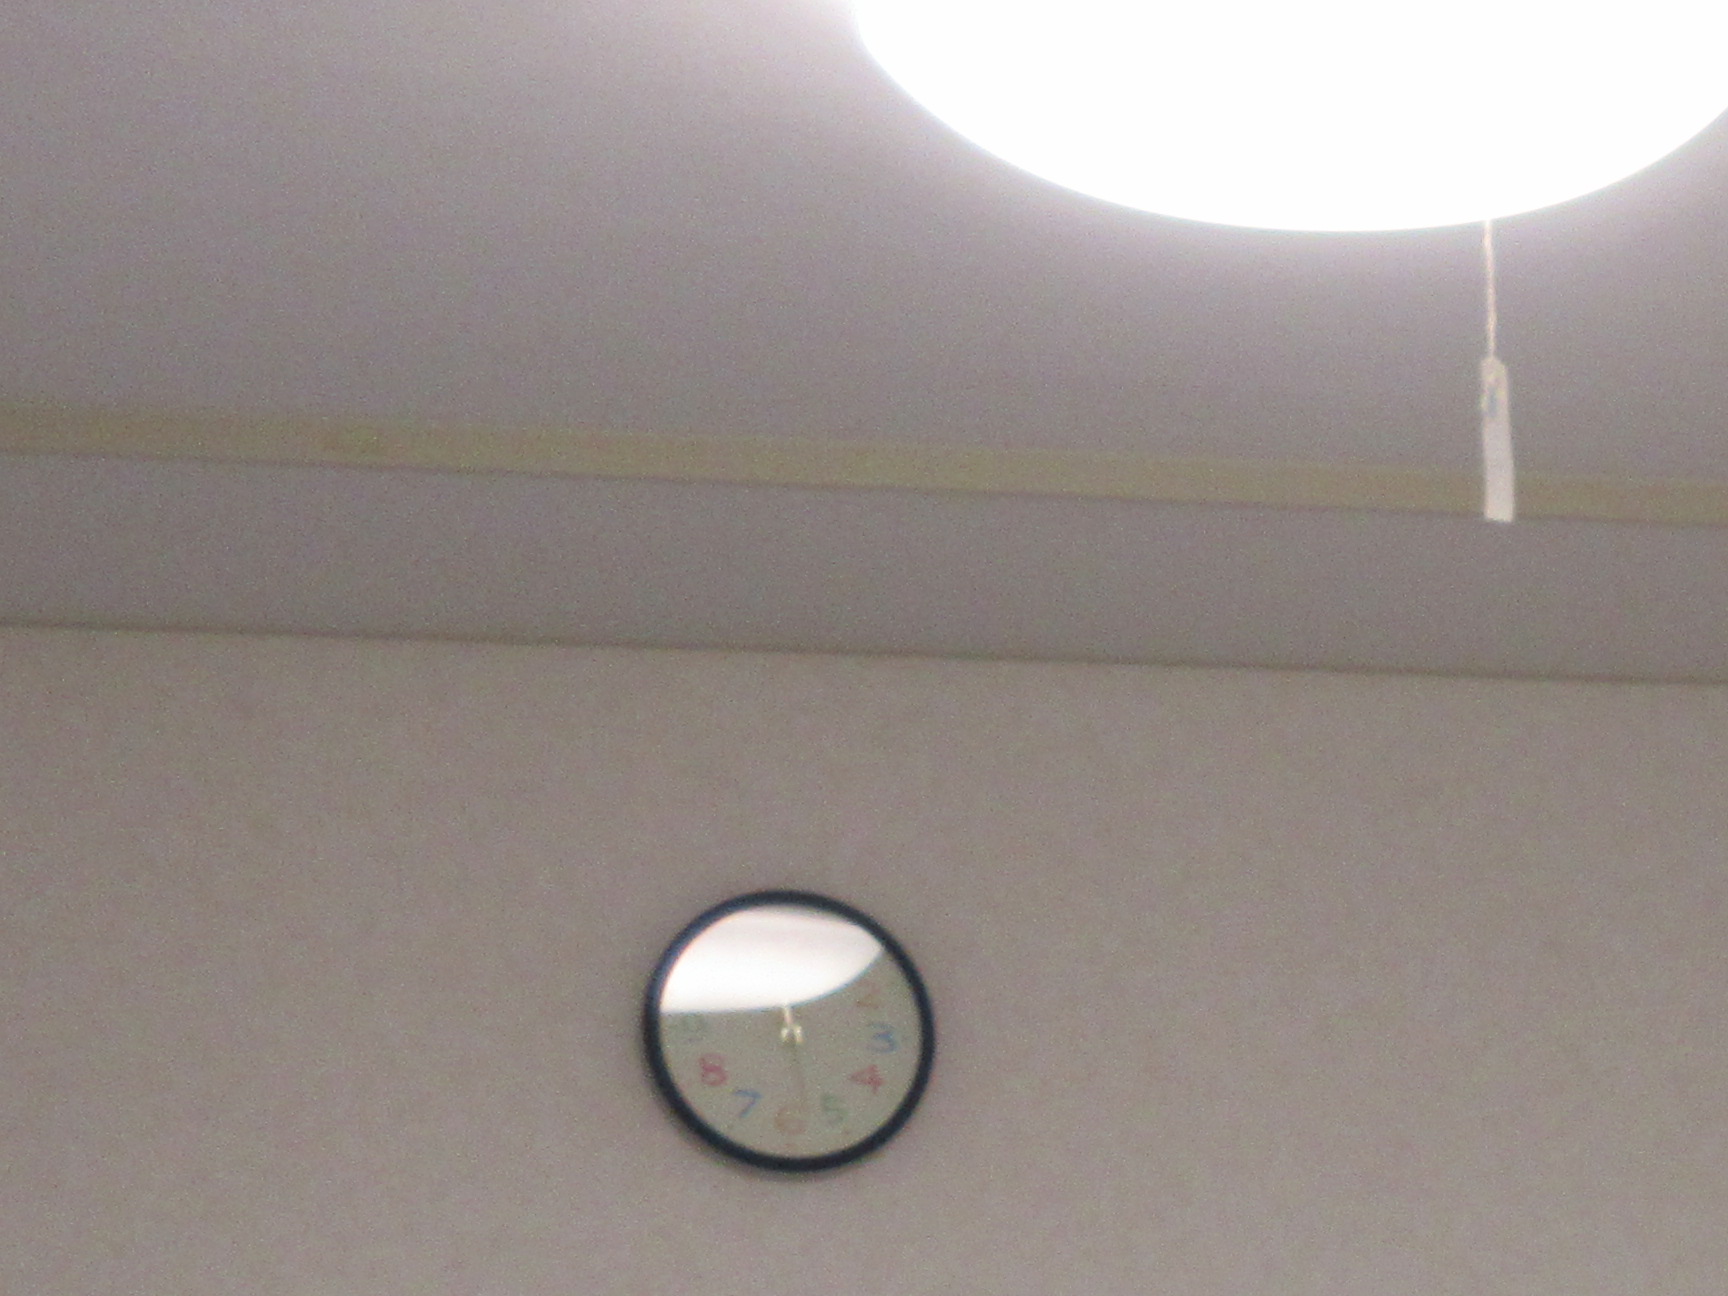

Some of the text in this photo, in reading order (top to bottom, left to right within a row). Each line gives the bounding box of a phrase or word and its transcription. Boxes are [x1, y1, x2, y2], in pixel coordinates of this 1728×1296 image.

[867, 1022, 898, 1054] 3
[698, 1053, 730, 1088] 8
[850, 1063, 885, 1097] 4
[733, 1089, 763, 1120] 7
